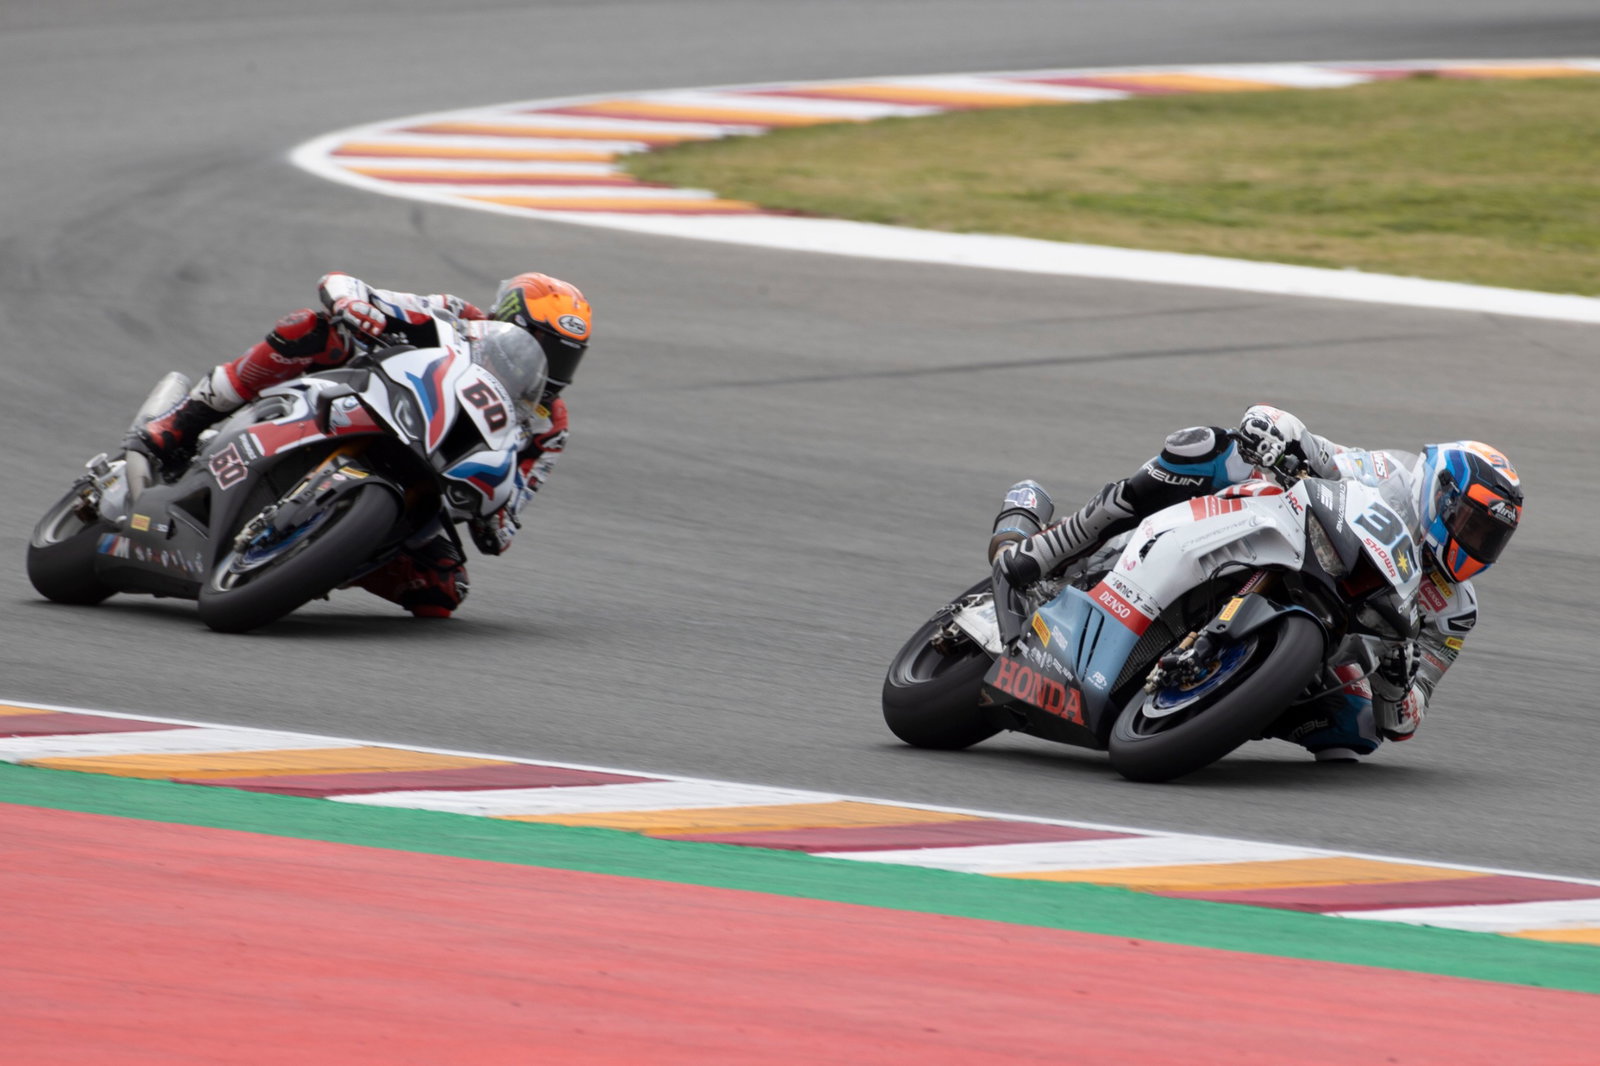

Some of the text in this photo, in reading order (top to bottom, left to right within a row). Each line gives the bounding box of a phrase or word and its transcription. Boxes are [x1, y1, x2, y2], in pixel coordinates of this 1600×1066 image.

[461, 376, 508, 434] 60
[208, 442, 248, 491] 60
[1286, 491, 1304, 516] HRC
[1491, 501, 1516, 521] Airoh
[1363, 537, 1397, 578] SHOWA
[1098, 590, 1131, 619] DENSO
[992, 656, 1085, 726] HONDA
